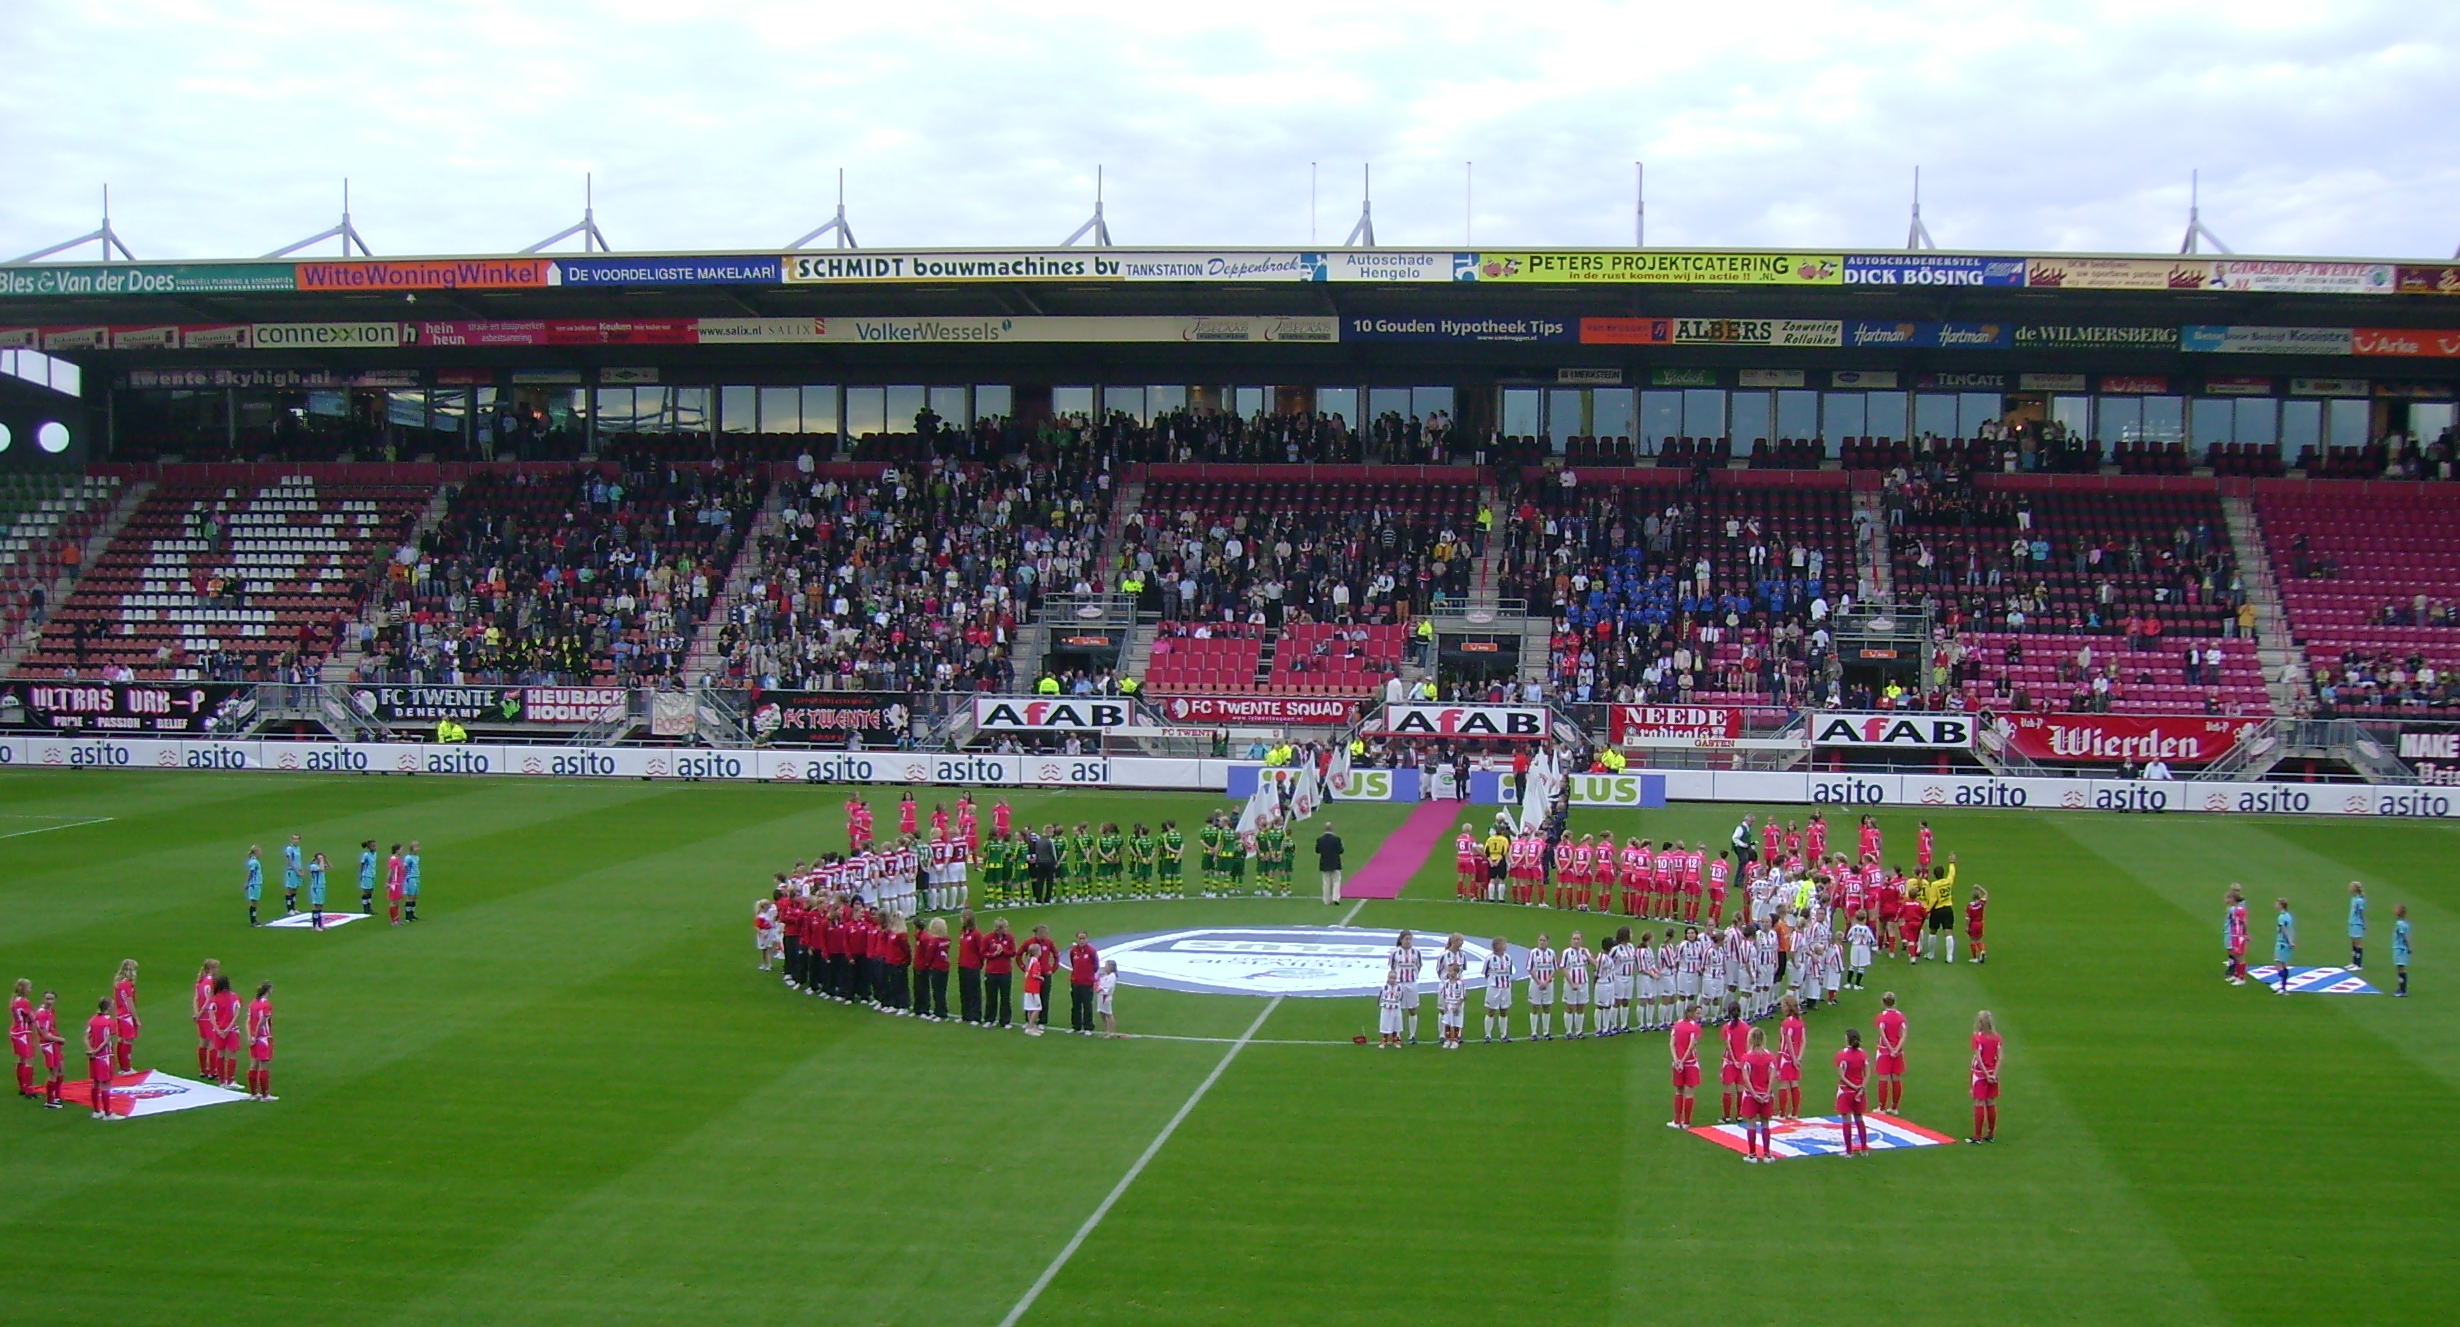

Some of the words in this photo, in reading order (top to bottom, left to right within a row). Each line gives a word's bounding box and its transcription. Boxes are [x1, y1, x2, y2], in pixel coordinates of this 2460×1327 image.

[799, 257, 904, 277] SCHMIDT
[913, 256, 1085, 276] bouwmachines
[1095, 256, 1121, 276] bv
[1125, 263, 1203, 276] TANKSTATION
[1346, 253, 1434, 266] Autoschade
[1529, 255, 1604, 273] PETERS
[1611, 256, 1790, 275] PROJEKTCATERING
[1847, 256, 1982, 266] AUTOSCHADEHERSTEL
[56, 271, 92, 292] Van
[95, 269, 126, 292] der
[128, 269, 175, 292] Does
[303, 263, 540, 288] WitteWoningWinkel
[569, 267, 589, 281] DE
[592, 267, 694, 281] VOORDELIGSTE
[697, 264, 776, 280] MAKELAAR!
[1360, 267, 1421, 281] Hengelo
[1583, 272, 1599, 280] de
[1629, 272, 1670, 280] komen
[1673, 272, 1692, 282] wij
[1694, 272, 1705, 280] in
[1709, 272, 1739, 280] actie
[1844, 268, 1897, 285] DICK
[1902, 265, 1984, 286] BÖSING
[257, 325, 396, 343] connexxion
[425, 322, 454, 334] hein
[700, 325, 762, 336] www.salix.nl
[856, 322, 1000, 341] VolkerWessels
[1353, 319, 1373, 332] 10
[1375, 319, 1436, 333] Gouden
[1440, 320, 1526, 336] Hypotheek
[1530, 320, 1563, 337] Tips
[1675, 320, 1772, 340] ALBERS
[1854, 322, 1906, 347] Hartman
[1938, 323, 1990, 347] Hartman
[2015, 327, 2037, 340] de
[2040, 326, 2178, 342] WILMERSBERG
[433, 334, 466, 345] heun
[31, 687, 115, 712] ULTRAS
[381, 689, 406, 705] FC
[410, 688, 496, 706] TWENTE
[528, 689, 626, 705] HEUBACH
[395, 707, 482, 718] DENEKAMP
[783, 708, 806, 729] FC
[807, 708, 882, 729] TWENTE
[981, 701, 1126, 726] AfAB
[1191, 701, 1212, 714] FC
[1216, 701, 1282, 715] TWENTE
[1287, 702, 1344, 716] SQUAD
[1623, 707, 1728, 726] NEEDE
[97, 716, 141, 728] PASSION
[156, 717, 189, 730] BELIEF
[1394, 709, 1542, 734] AfAB
[1816, 717, 1968, 744] AfAB
[1176, 728, 1213, 737] TWENT
[2047, 724, 2200, 758] Wierden
[71, 740, 130, 765] asito
[186, 743, 246, 769] asito
[307, 744, 368, 771] asito
[428, 747, 489, 773] asito
[551, 749, 616, 775] asito
[677, 751, 742, 777] asito
[806, 754, 873, 781] asito
[937, 755, 1004, 782] asito
[1070, 756, 1108, 783] asi
[1569, 777, 1638, 803] LUS
[1813, 776, 1884, 804] asito
[1954, 778, 2027, 806] asito
[2095, 782, 2167, 810] asito
[2238, 785, 2310, 812] asito
[2379, 788, 2449, 816] asito
[1657, 859, 1667, 868] 10
[1688, 858, 1698, 868] 12
[1711, 867, 1722, 878] 13
